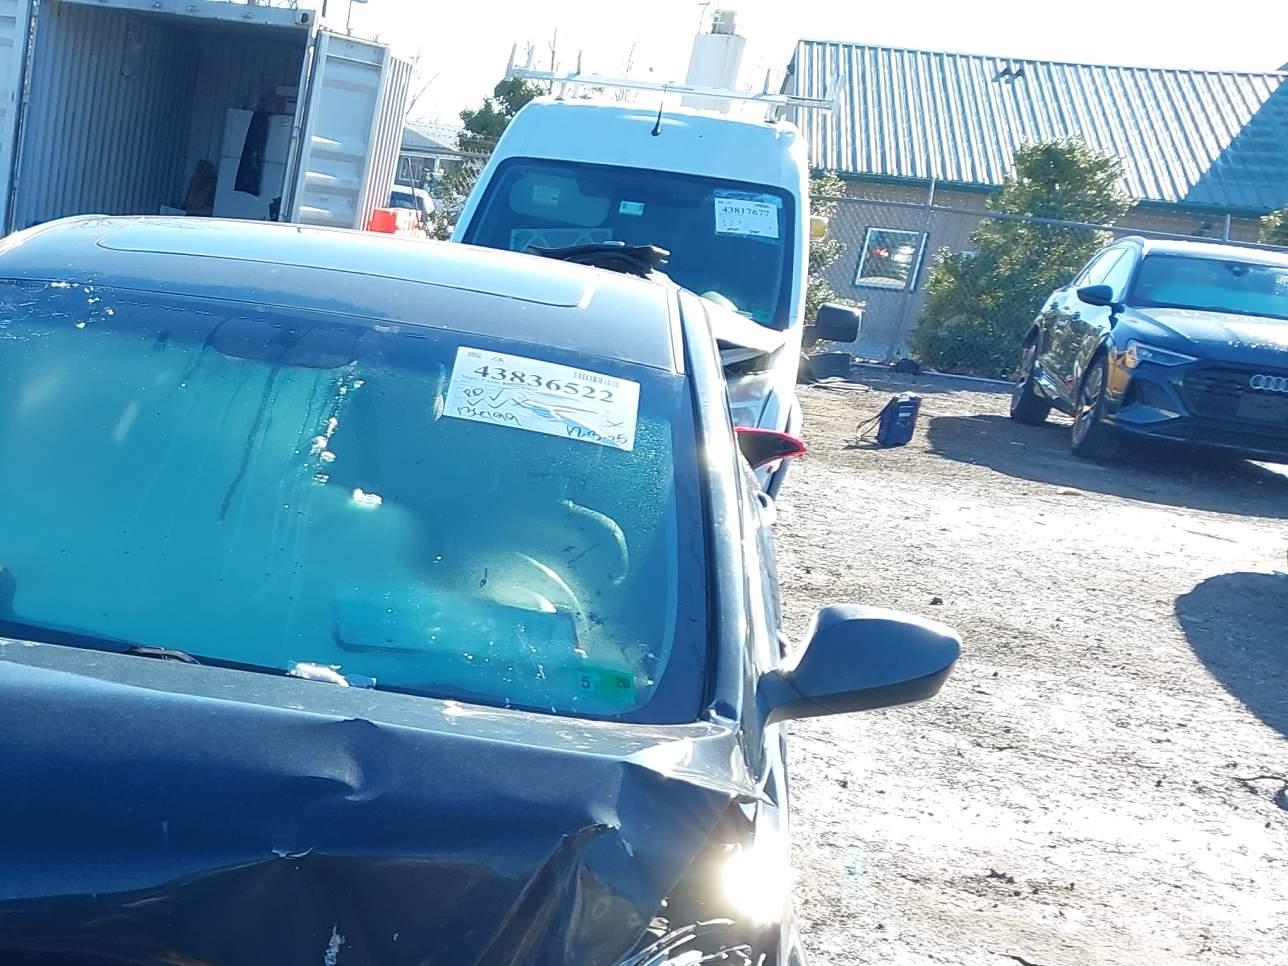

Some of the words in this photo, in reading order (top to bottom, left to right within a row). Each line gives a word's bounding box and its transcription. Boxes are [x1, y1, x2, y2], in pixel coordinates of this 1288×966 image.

[721, 206, 770, 217] 43817677
[473, 365, 614, 404] 43836522
[581, 675, 591, 689] 5
